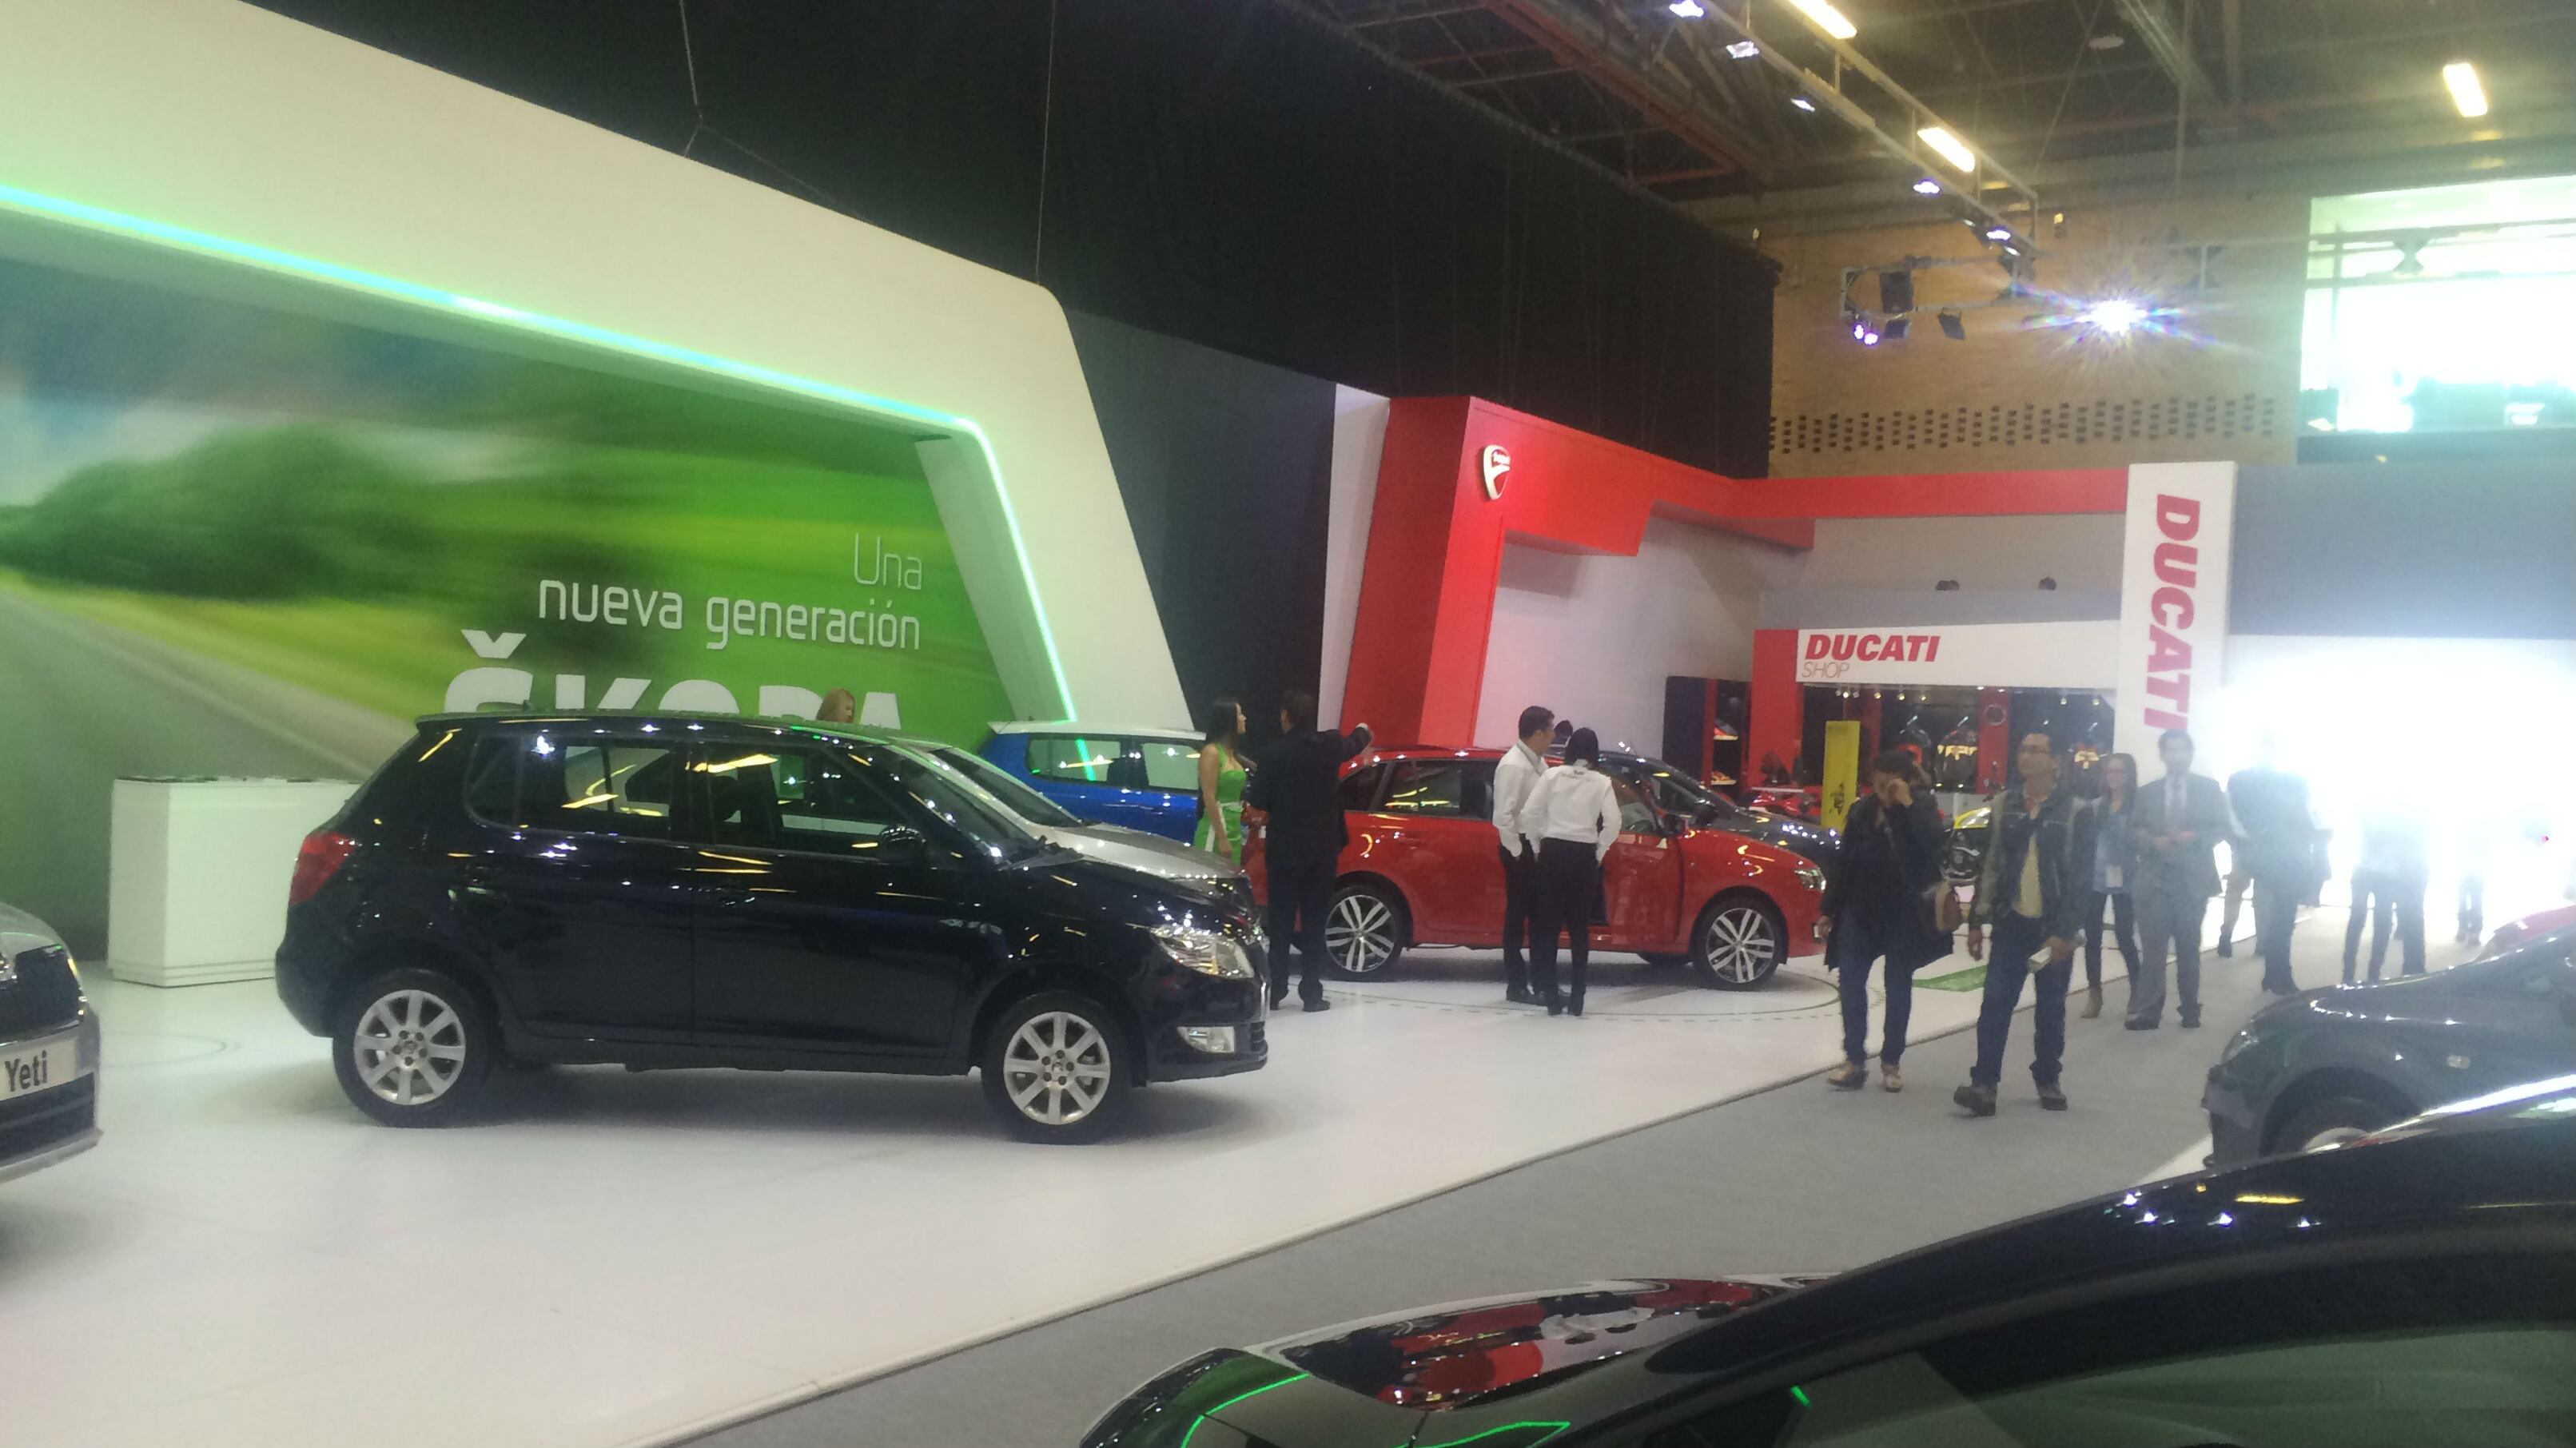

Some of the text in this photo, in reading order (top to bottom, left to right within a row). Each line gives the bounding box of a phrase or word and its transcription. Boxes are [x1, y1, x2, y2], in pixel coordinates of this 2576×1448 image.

[853, 532, 922, 591] Una
[539, 579, 921, 650] nueva generación
[2144, 493, 2201, 730] DUCATI
[1801, 662, 1850, 678] SHOP
[1804, 634, 1941, 662] DUCATI
[5, 1049, 49, 1092] Yeti
